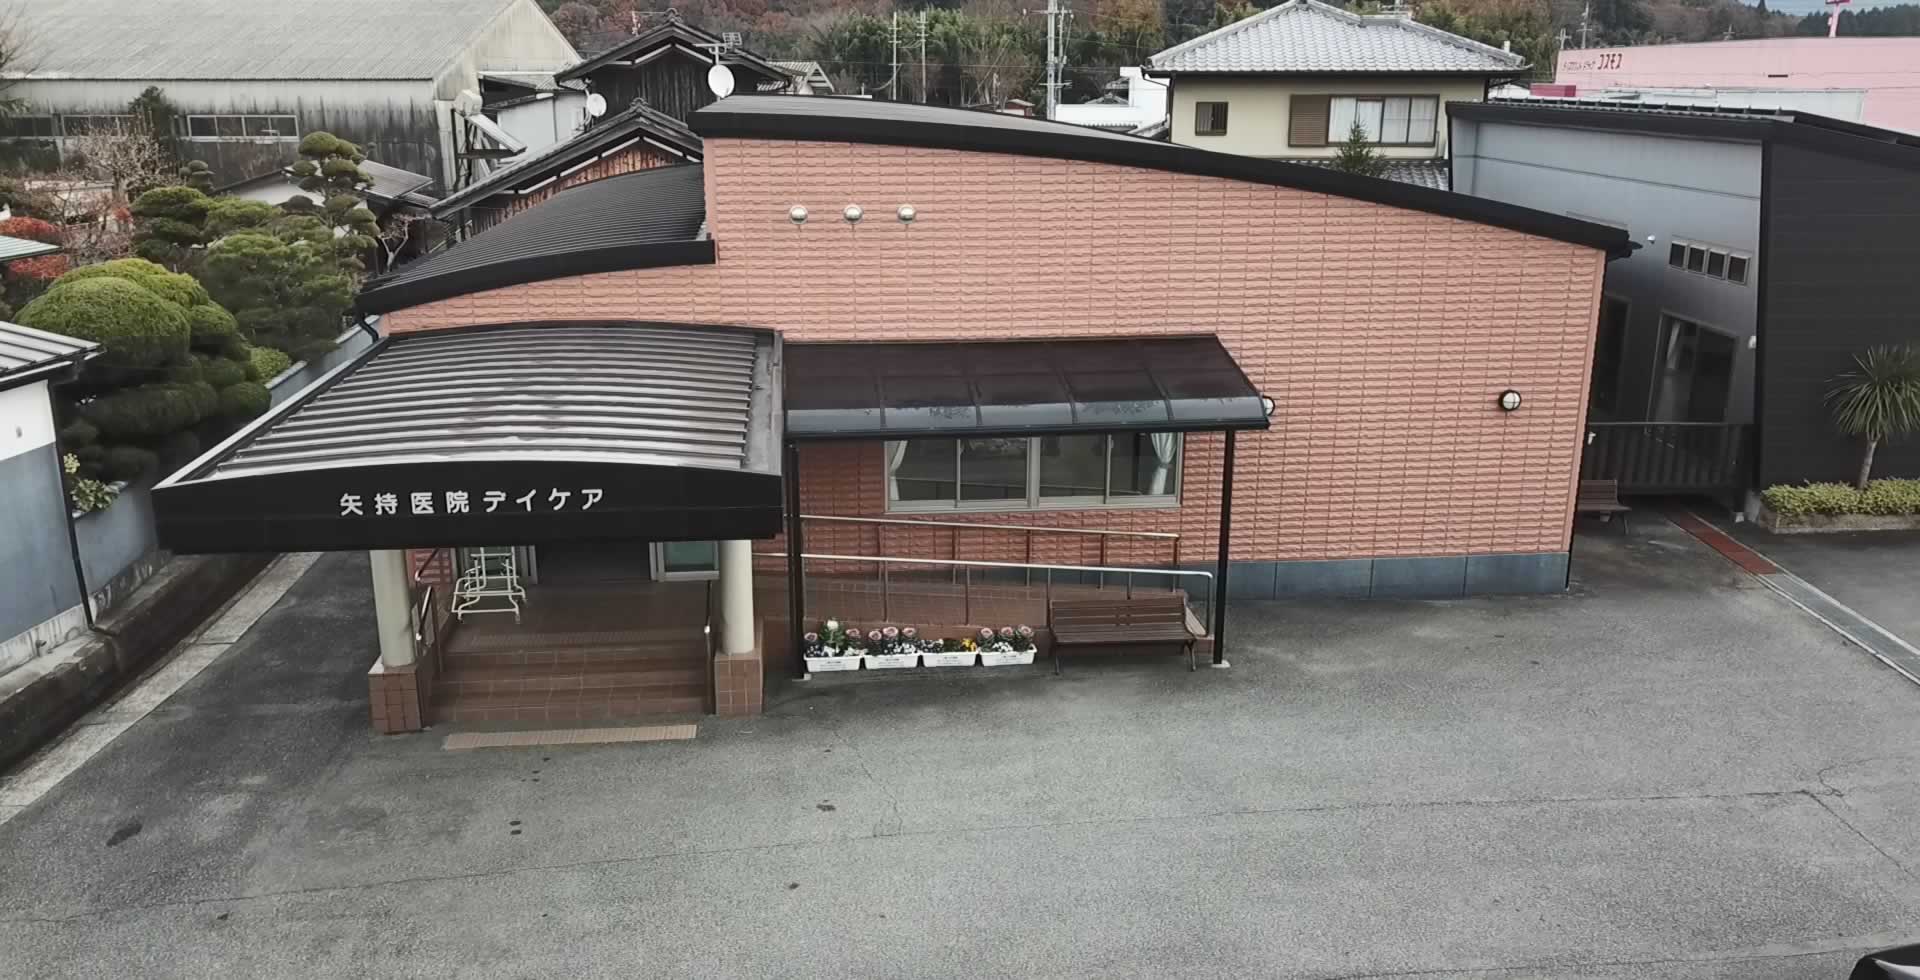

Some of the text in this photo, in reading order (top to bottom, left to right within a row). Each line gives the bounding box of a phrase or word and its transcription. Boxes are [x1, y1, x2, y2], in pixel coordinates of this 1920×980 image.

[340, 487, 603, 516] 矢持医院デイケア
